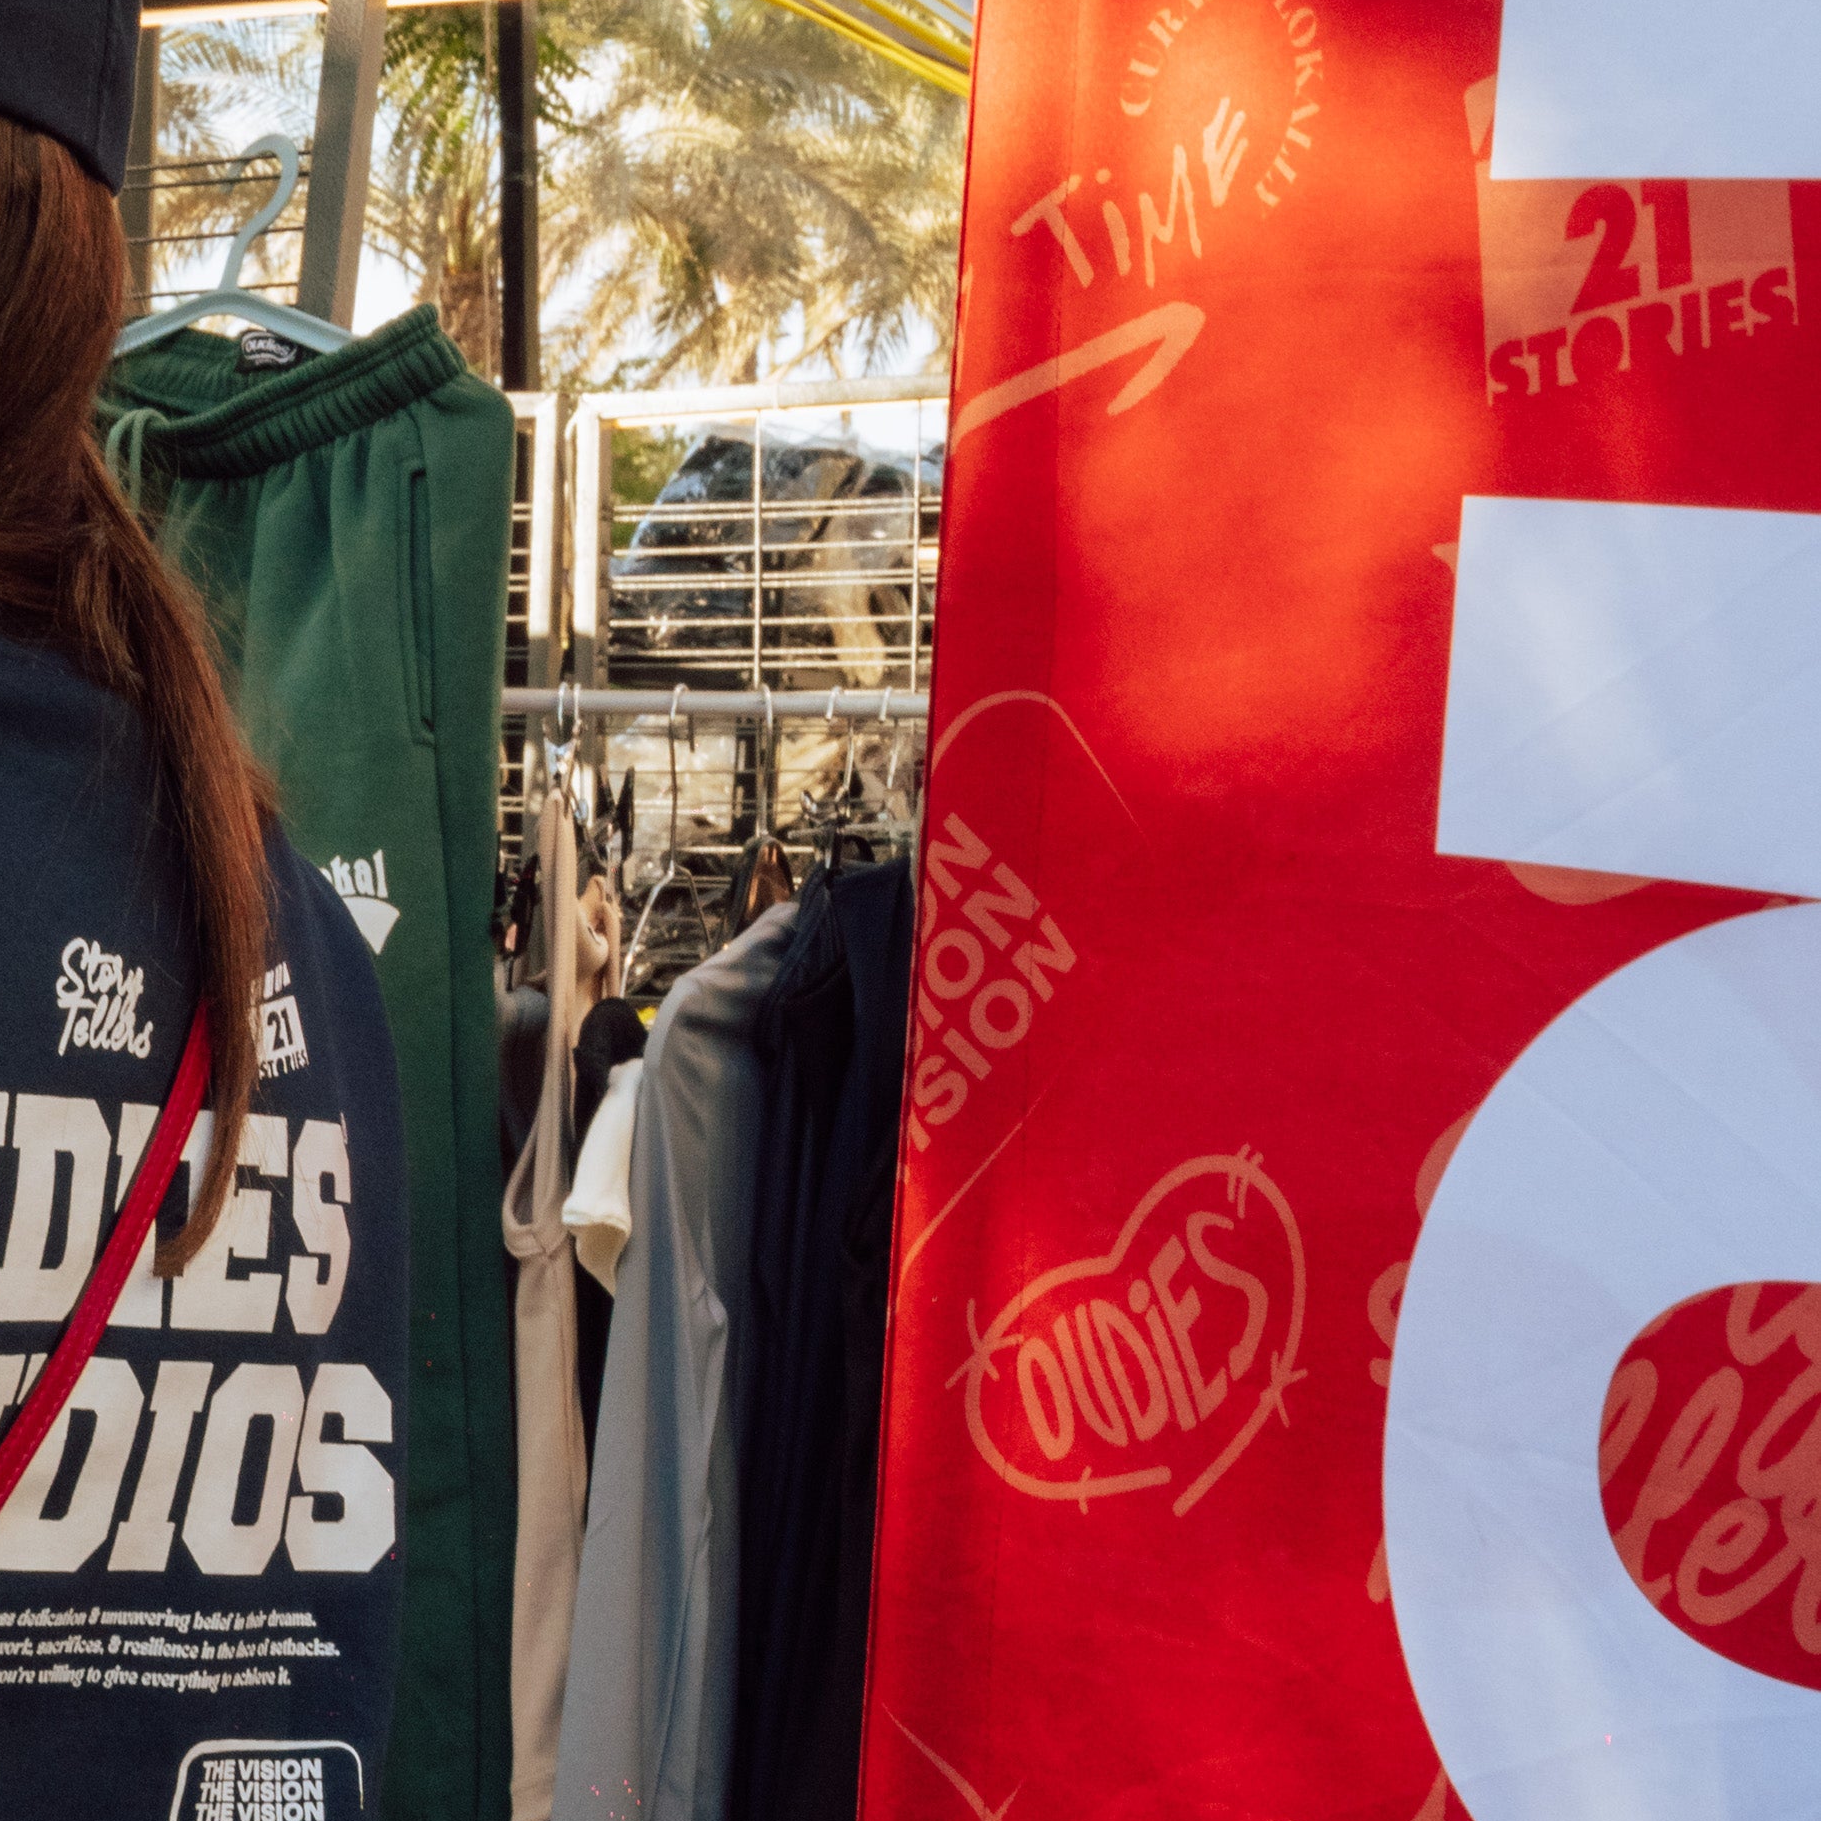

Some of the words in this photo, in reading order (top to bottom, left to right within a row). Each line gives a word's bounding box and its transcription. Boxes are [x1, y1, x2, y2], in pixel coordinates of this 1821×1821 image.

[1564, 179, 1693, 316] 21
[1488, 266, 1798, 404] STORIES
[319, 848, 389, 899] kal
[56, 937, 144, 1015] Story
[57, 994, 154, 1058] Tellers
[267, 1008, 294, 1052] 21
[17, 1607, 87, 1627] dedication
[100, 1607, 191, 1634] unwavering
[192, 1610, 234, 1632] belief
[107, 1634, 122, 1655] &
[122, 1636, 199, 1659] resilience
[200, 1640, 216, 1660] in
[269, 1637, 341, 1657] setbacks.
[86, 1666, 102, 1684] to
[102, 1665, 139, 1690] give
[140, 1669, 221, 1693] everything
[200, 1781, 235, 1803] THE
[237, 1779, 324, 1803] VISION
[203, 1759, 236, 1781] THE
[237, 1758, 323, 1781] VISION
